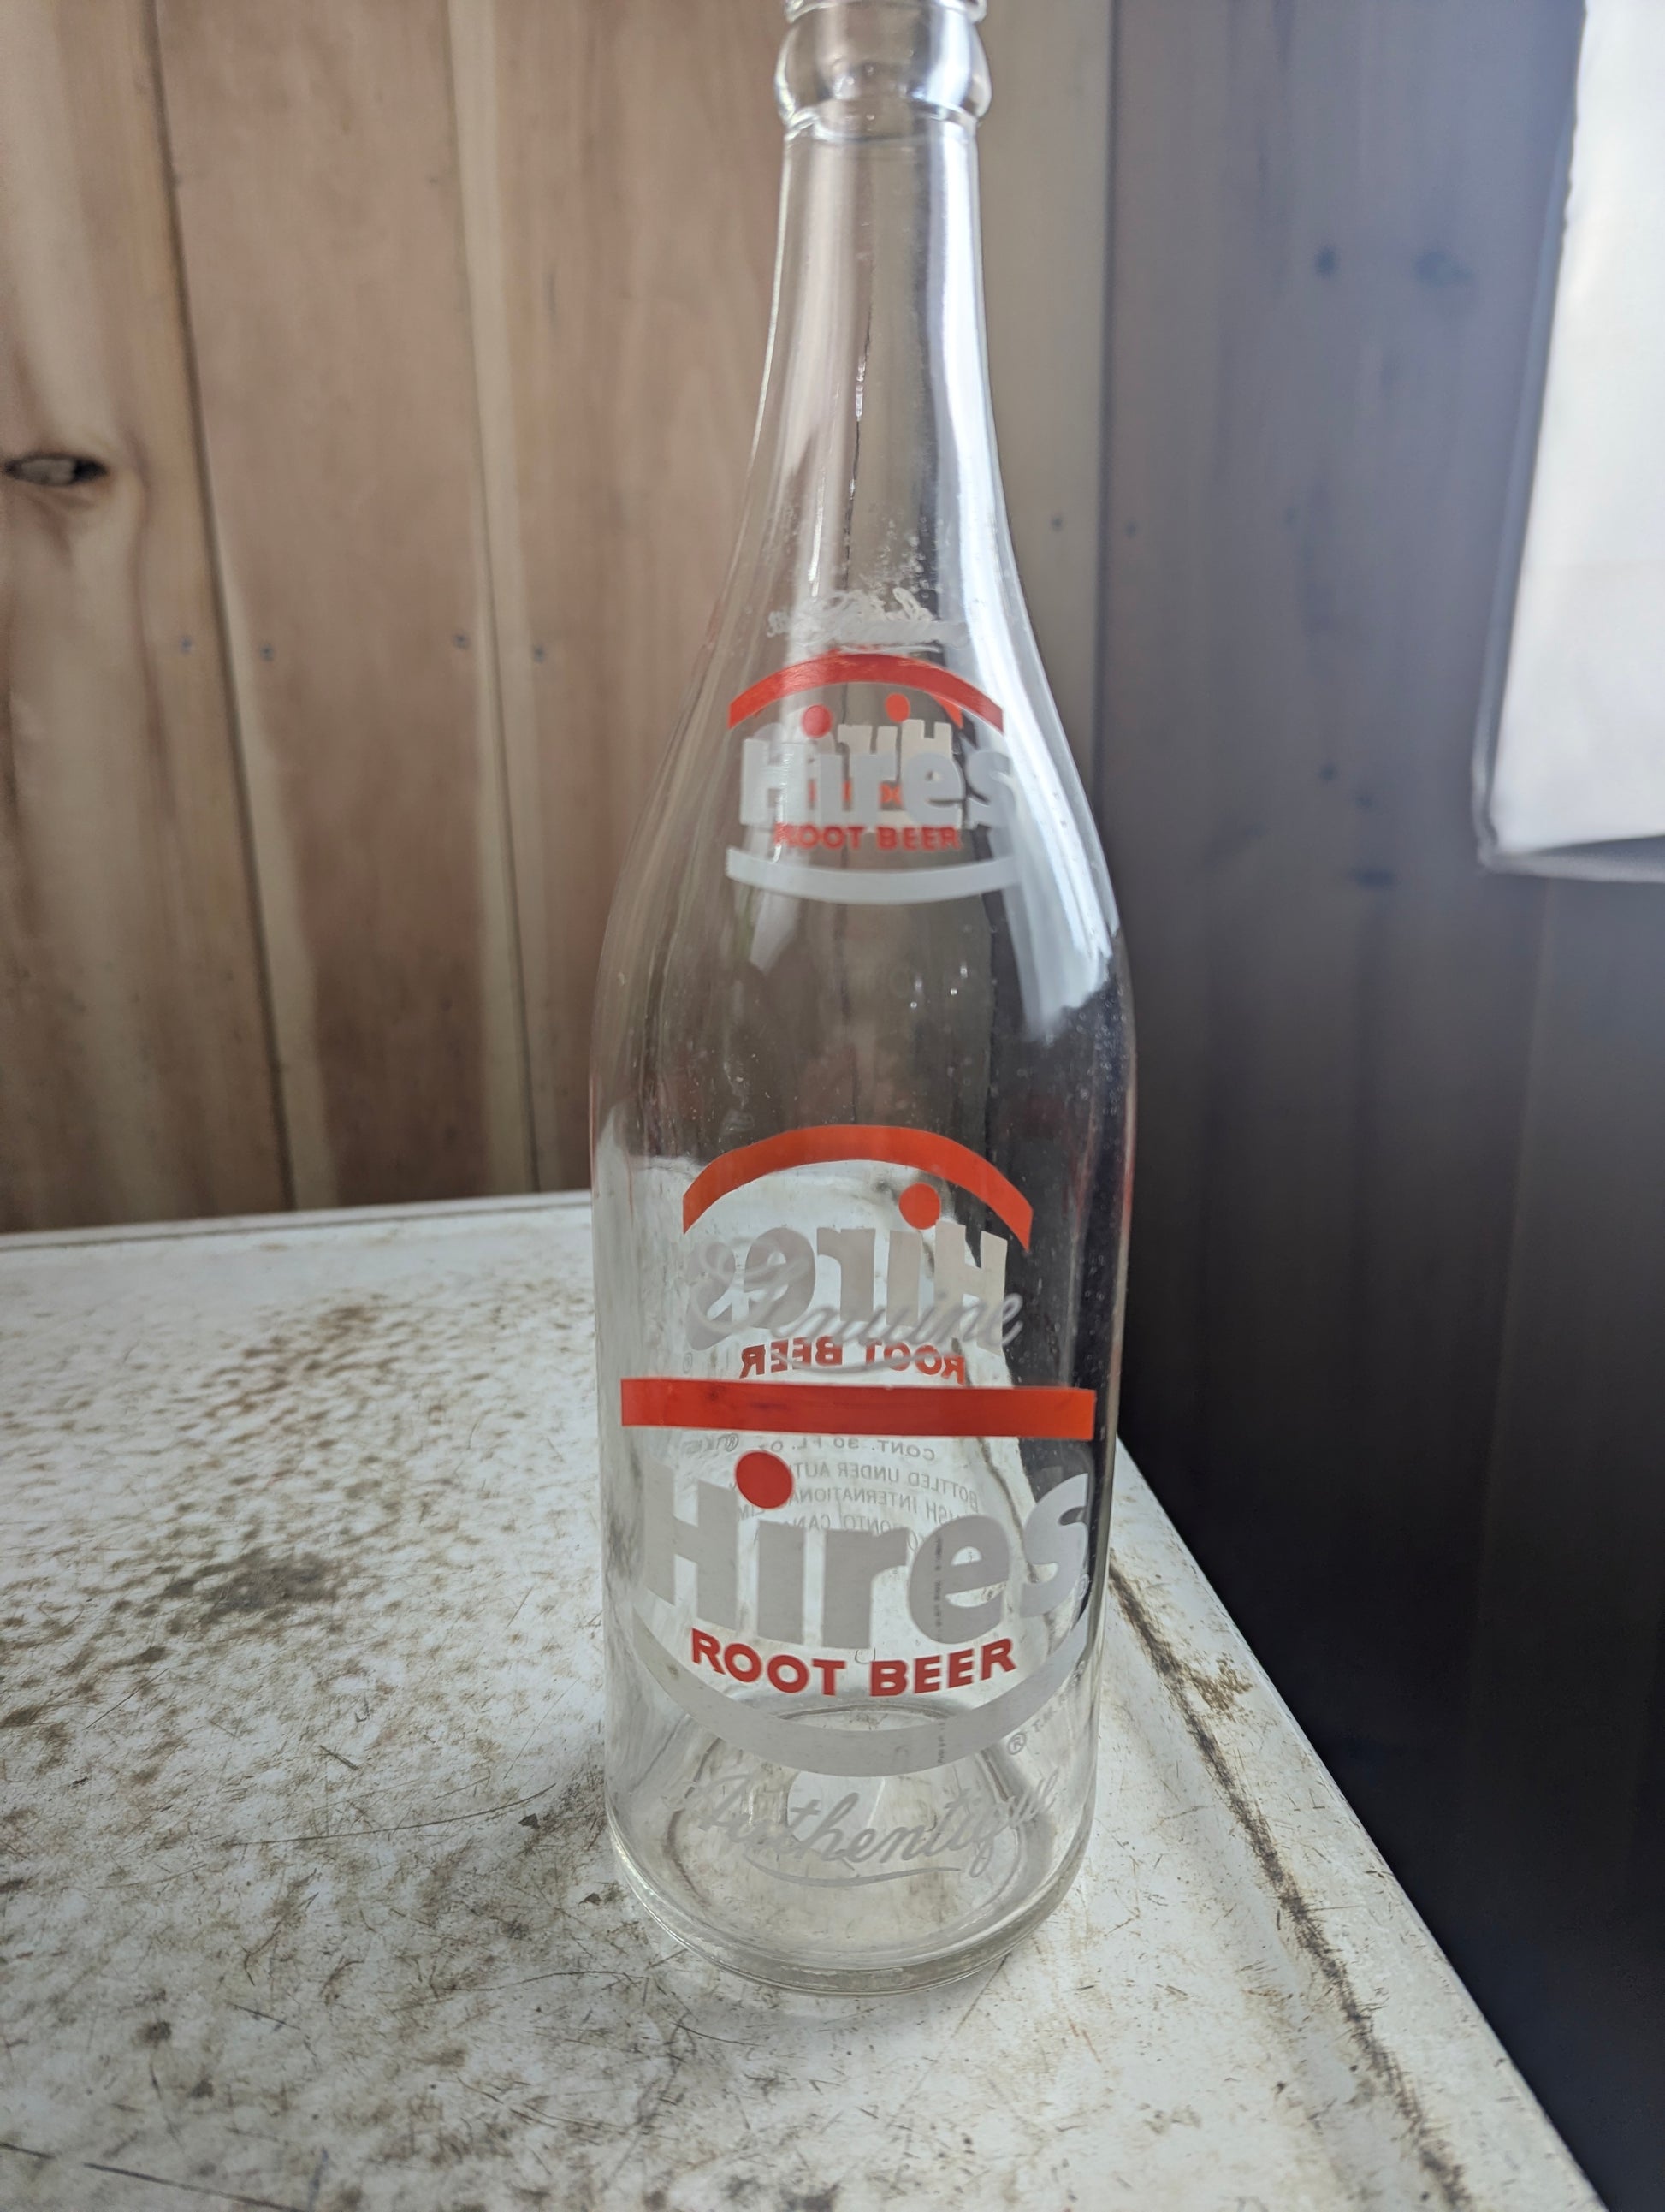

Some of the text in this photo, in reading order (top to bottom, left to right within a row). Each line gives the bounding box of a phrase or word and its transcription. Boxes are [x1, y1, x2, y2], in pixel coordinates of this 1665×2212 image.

[740, 703, 1017, 828] Hires
[774, 823, 961, 851] ROOT BEER
[643, 1450, 1089, 1650] Hires
[690, 1628, 846, 1696] ROOT
[869, 1638, 1016, 1697] BEER
